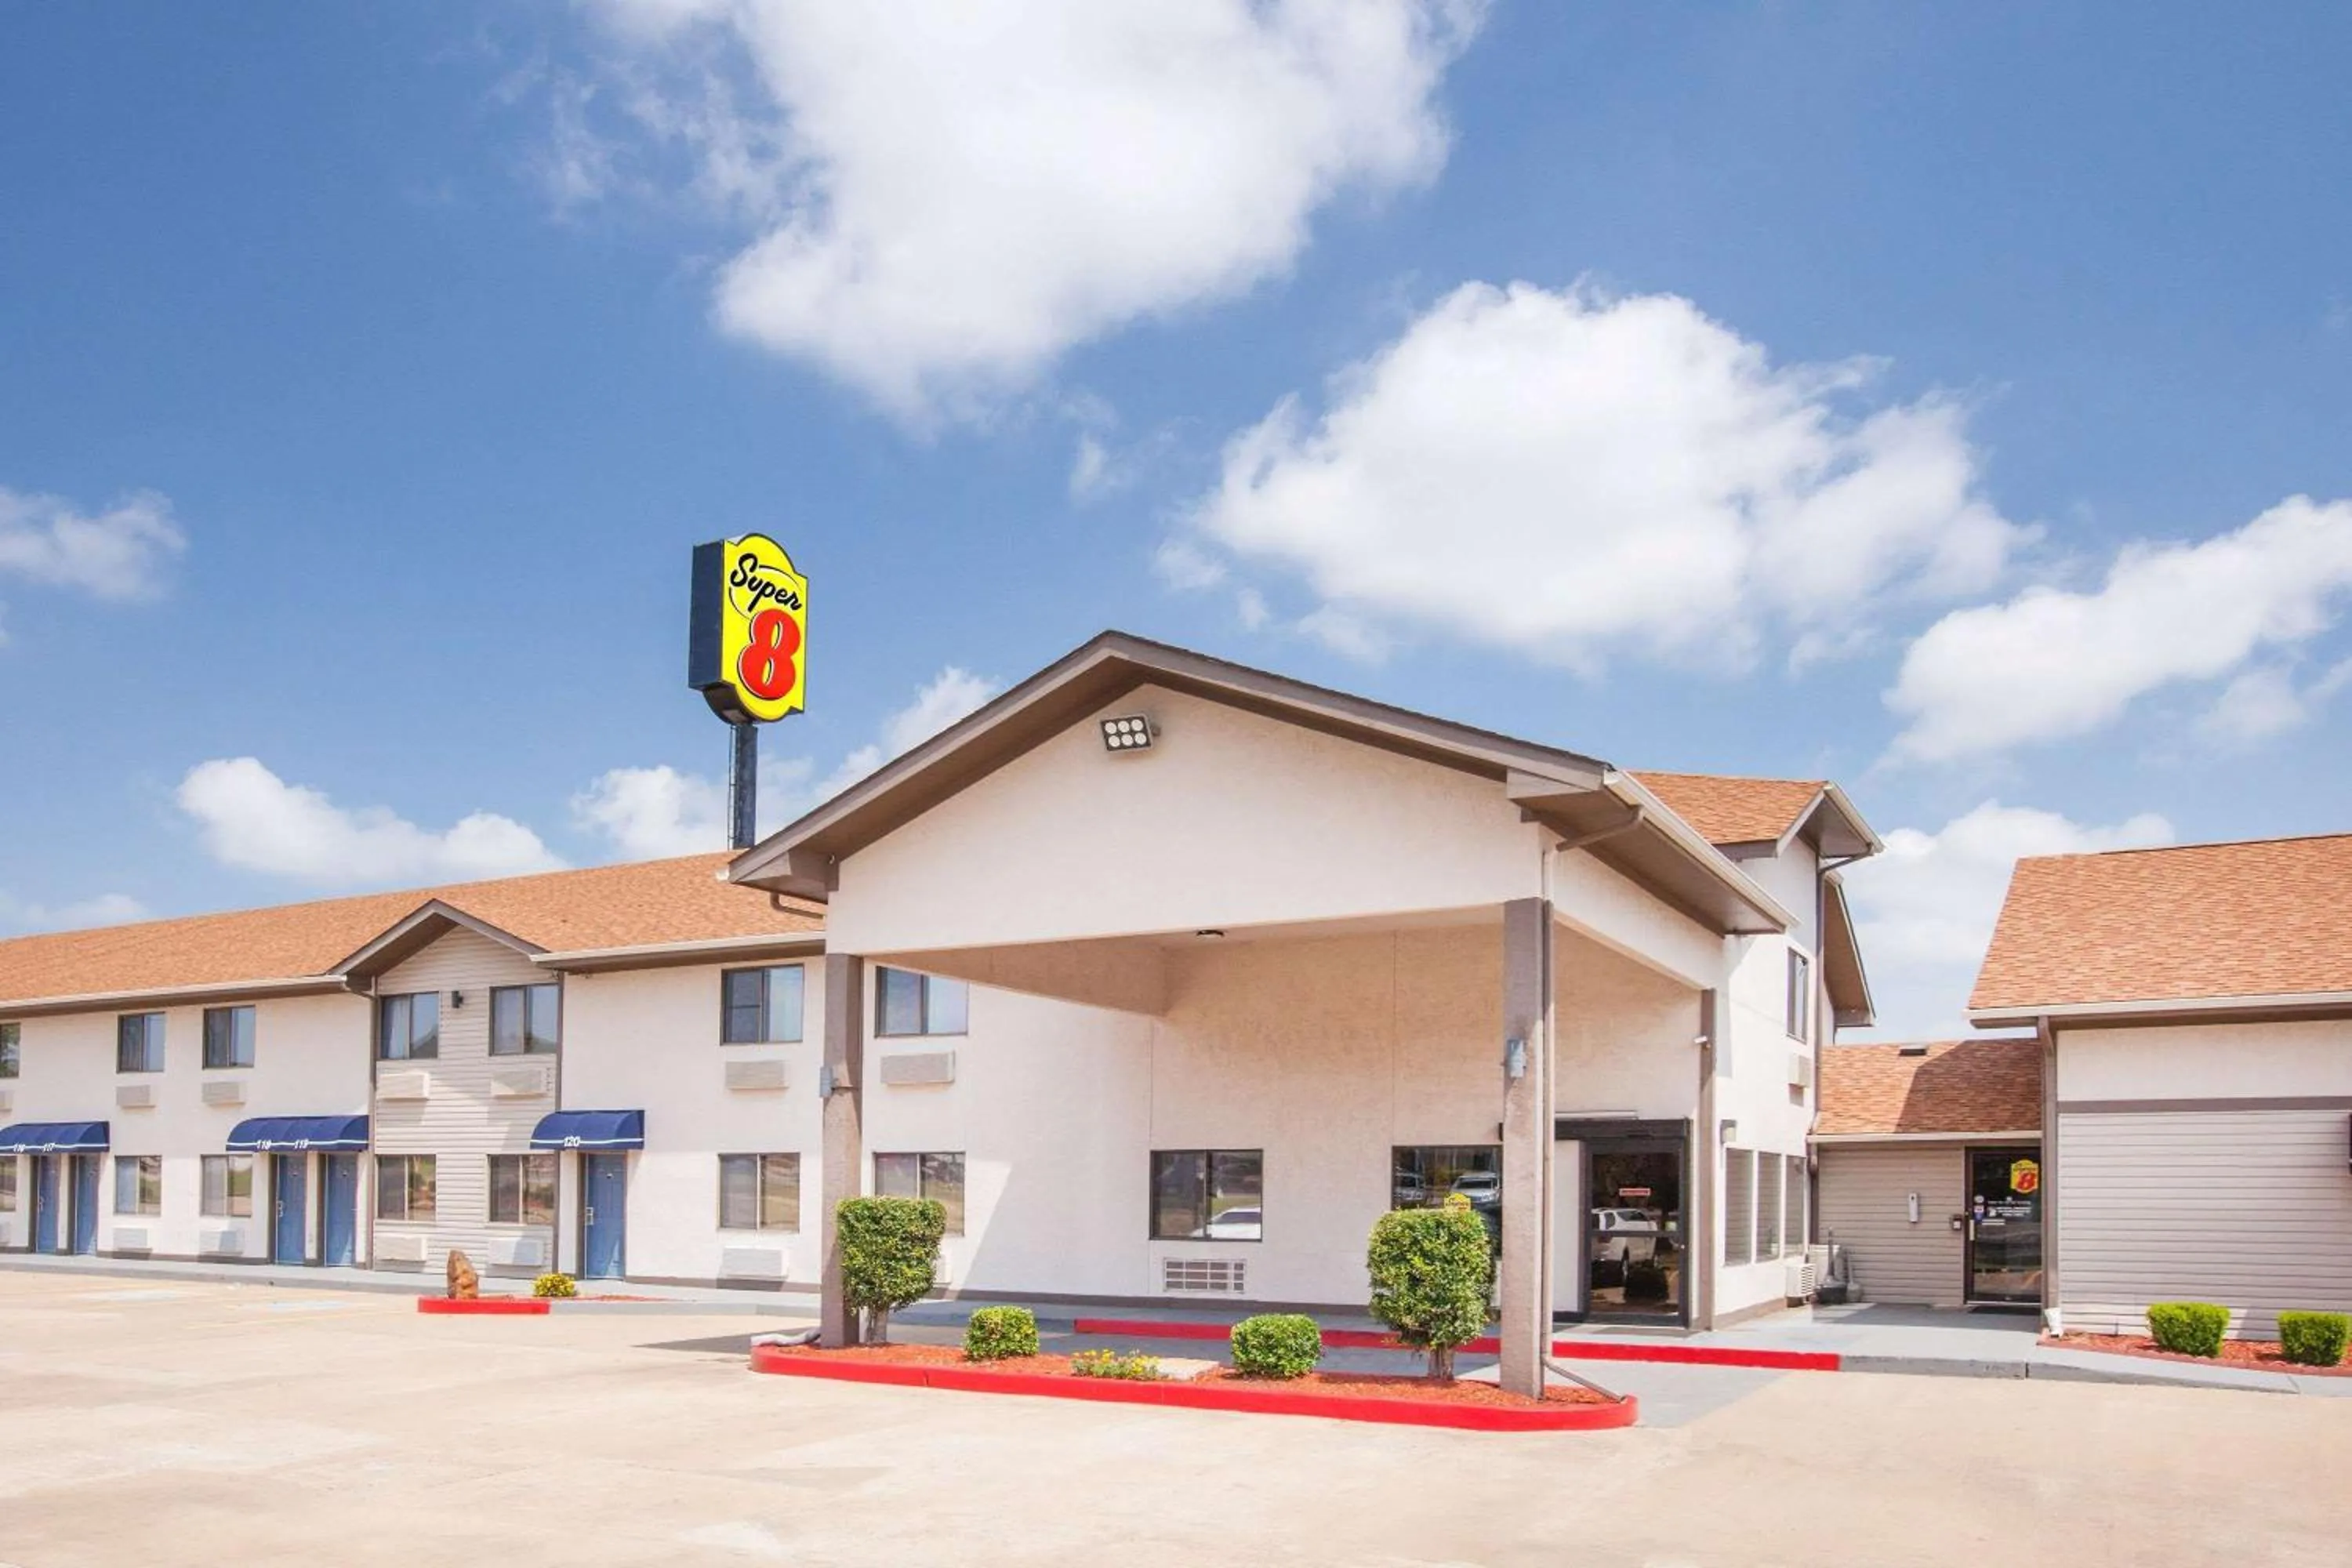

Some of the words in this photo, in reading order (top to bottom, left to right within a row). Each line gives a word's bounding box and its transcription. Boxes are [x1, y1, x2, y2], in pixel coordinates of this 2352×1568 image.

[730, 553, 802, 612] Super
[738, 608, 801, 701] 8
[564, 1135, 580, 1147] 120
[2017, 1171, 2037, 1190] 8
